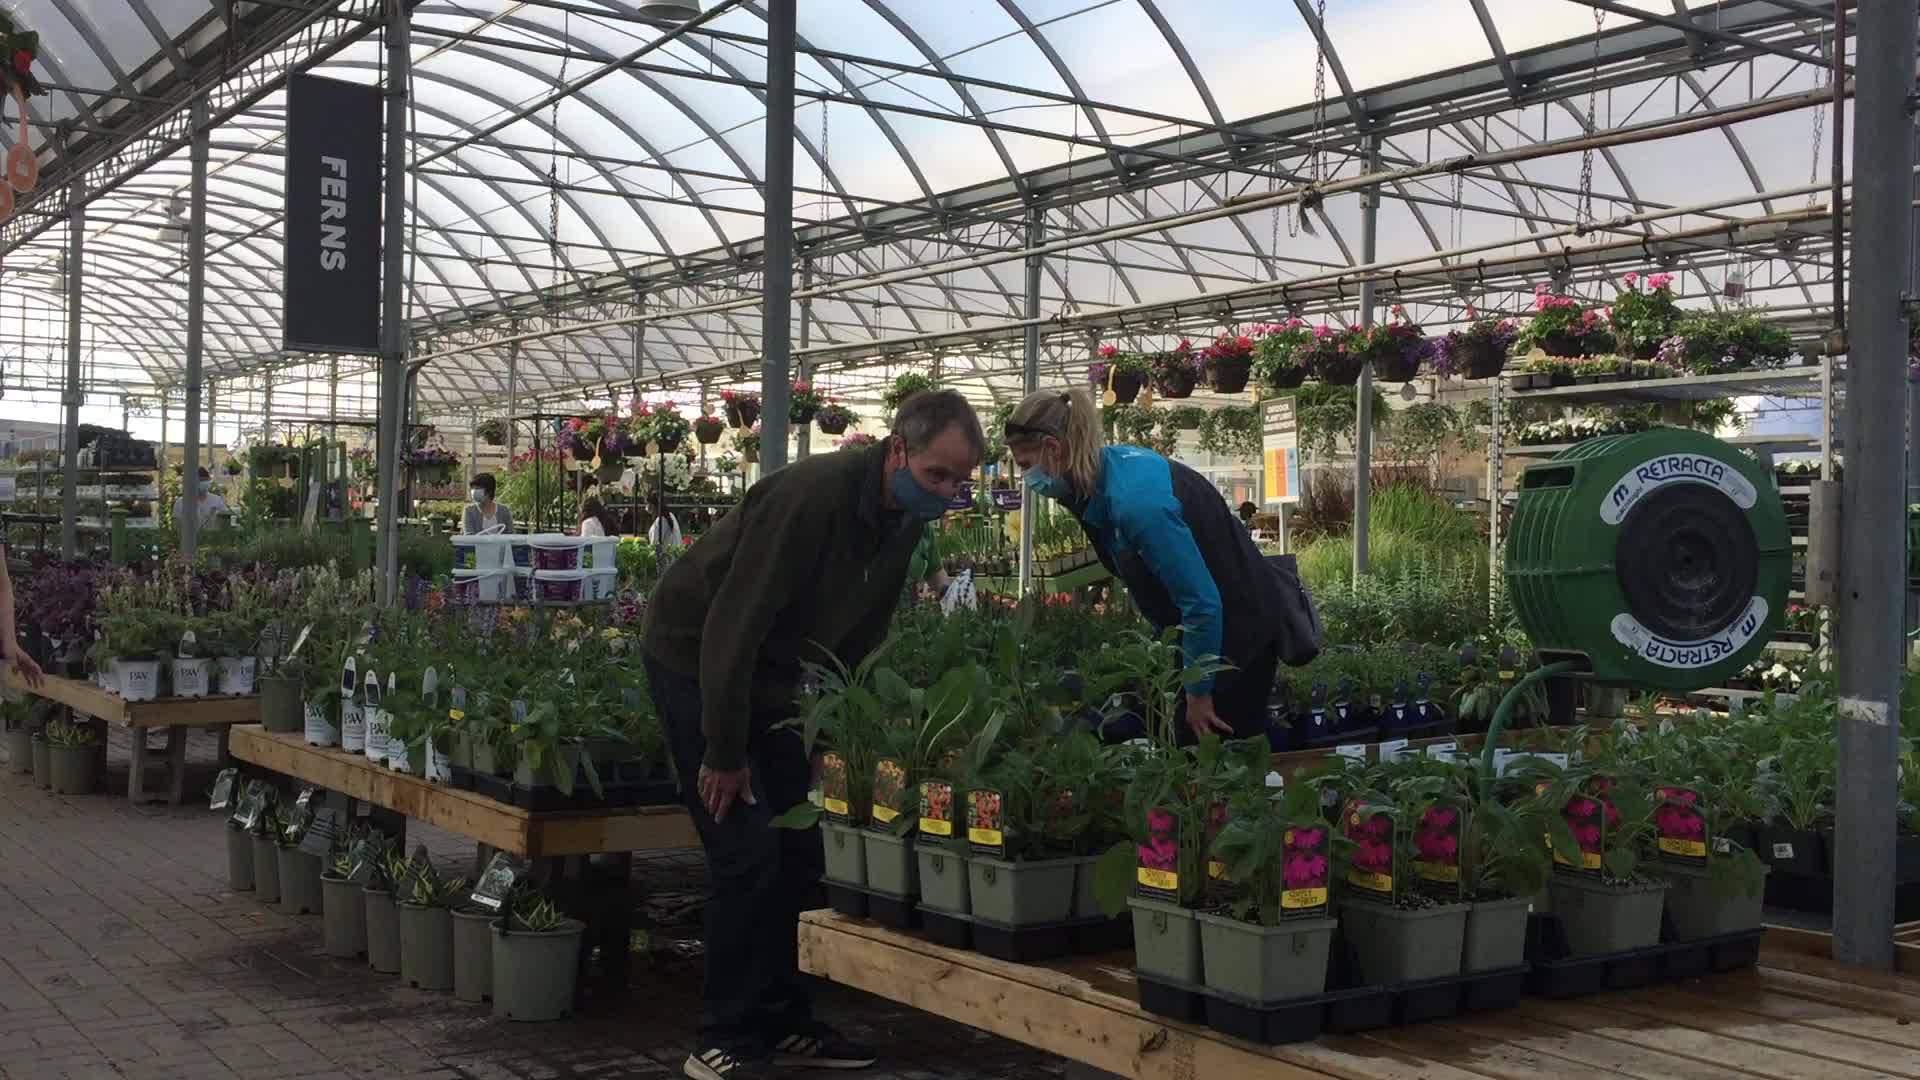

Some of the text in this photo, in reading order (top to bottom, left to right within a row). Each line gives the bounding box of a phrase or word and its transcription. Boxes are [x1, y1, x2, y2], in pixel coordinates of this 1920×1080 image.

[320, 155, 347, 271] FERNS
[1636, 457, 1723, 484] RETRACTA
[1646, 634, 1733, 664] RETRACTA
